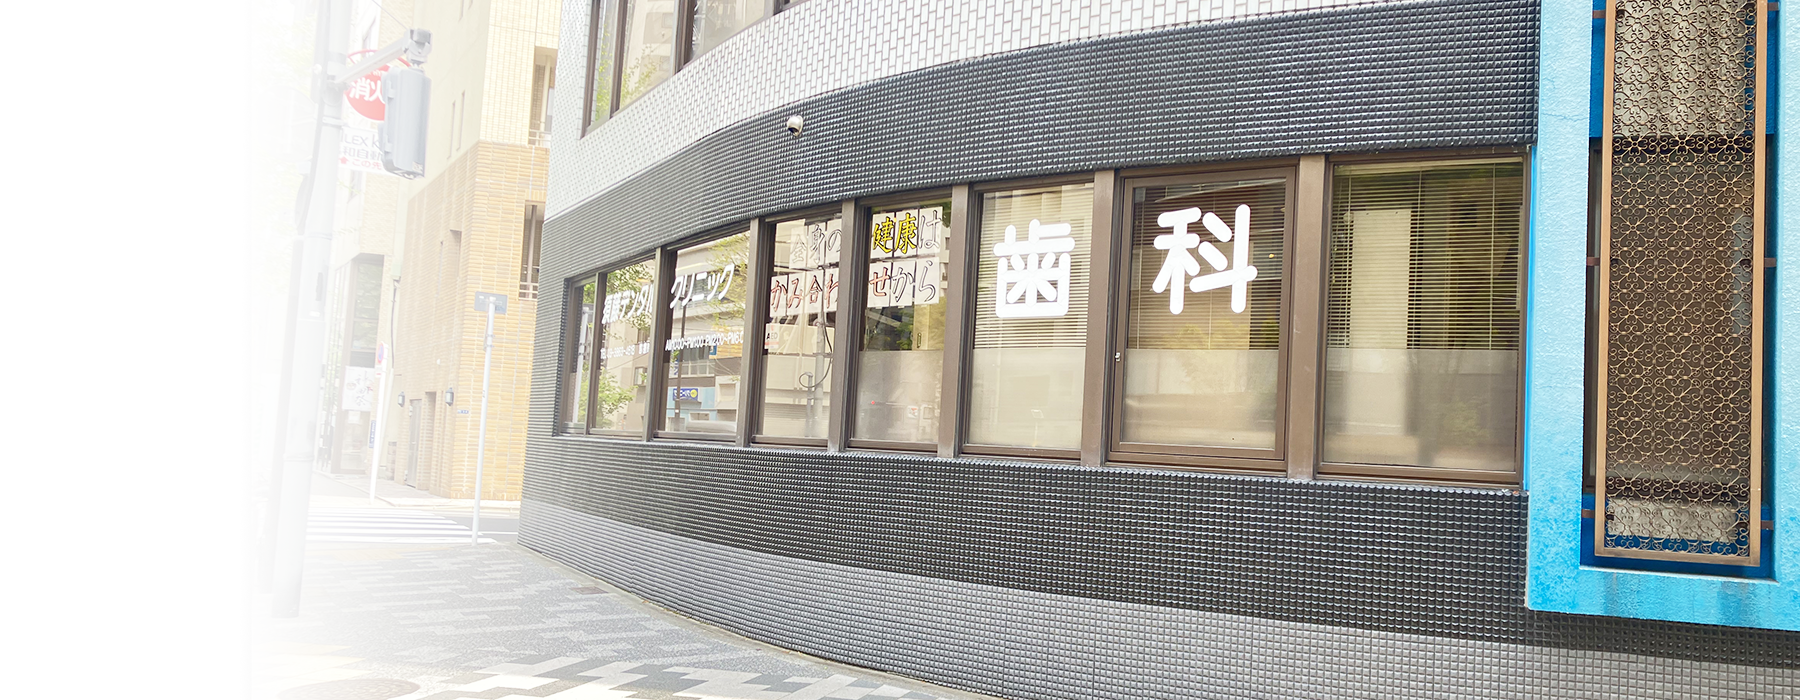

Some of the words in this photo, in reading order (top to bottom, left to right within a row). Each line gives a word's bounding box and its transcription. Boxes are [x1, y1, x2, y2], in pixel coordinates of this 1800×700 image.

[340, 146, 381, 161] 和自動
[352, 158, 382, 170] この先
[766, 332, 779, 340] AED
